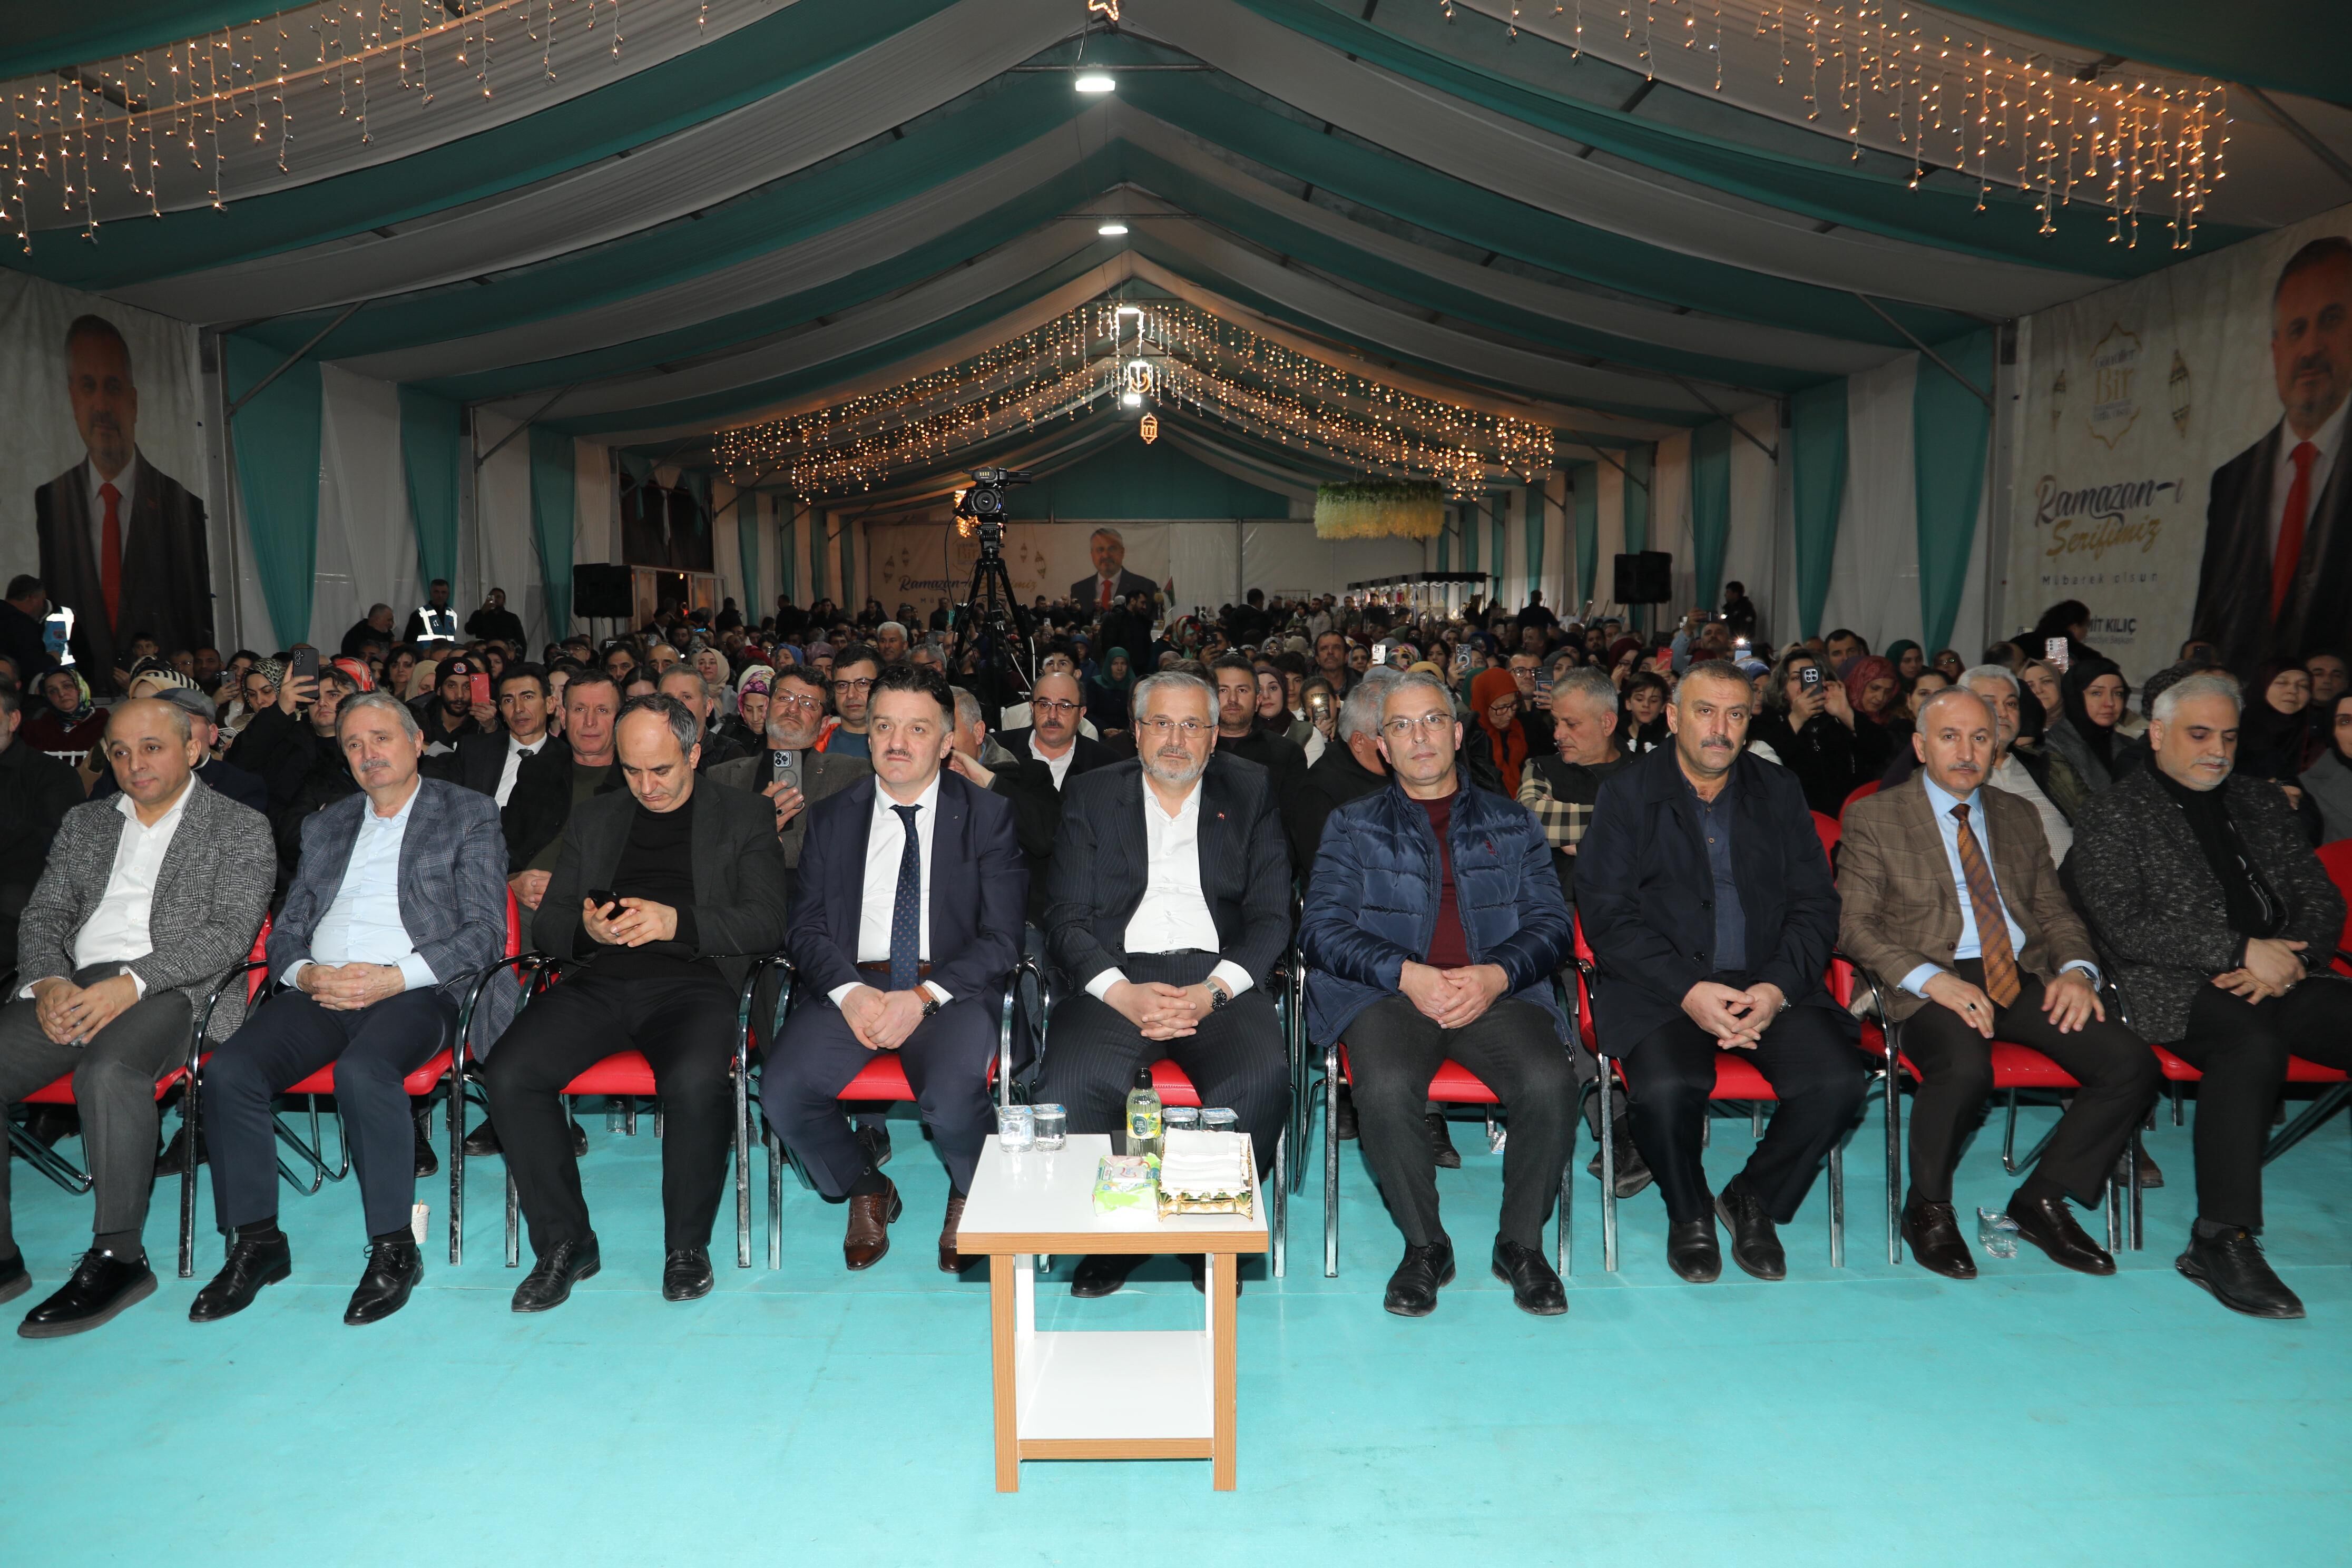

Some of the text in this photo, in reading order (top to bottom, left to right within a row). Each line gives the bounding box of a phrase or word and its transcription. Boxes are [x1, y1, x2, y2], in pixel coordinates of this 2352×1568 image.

[2095, 368, 2134, 405] Bir
[2087, 615, 2137, 635] MİT KILIÇ
